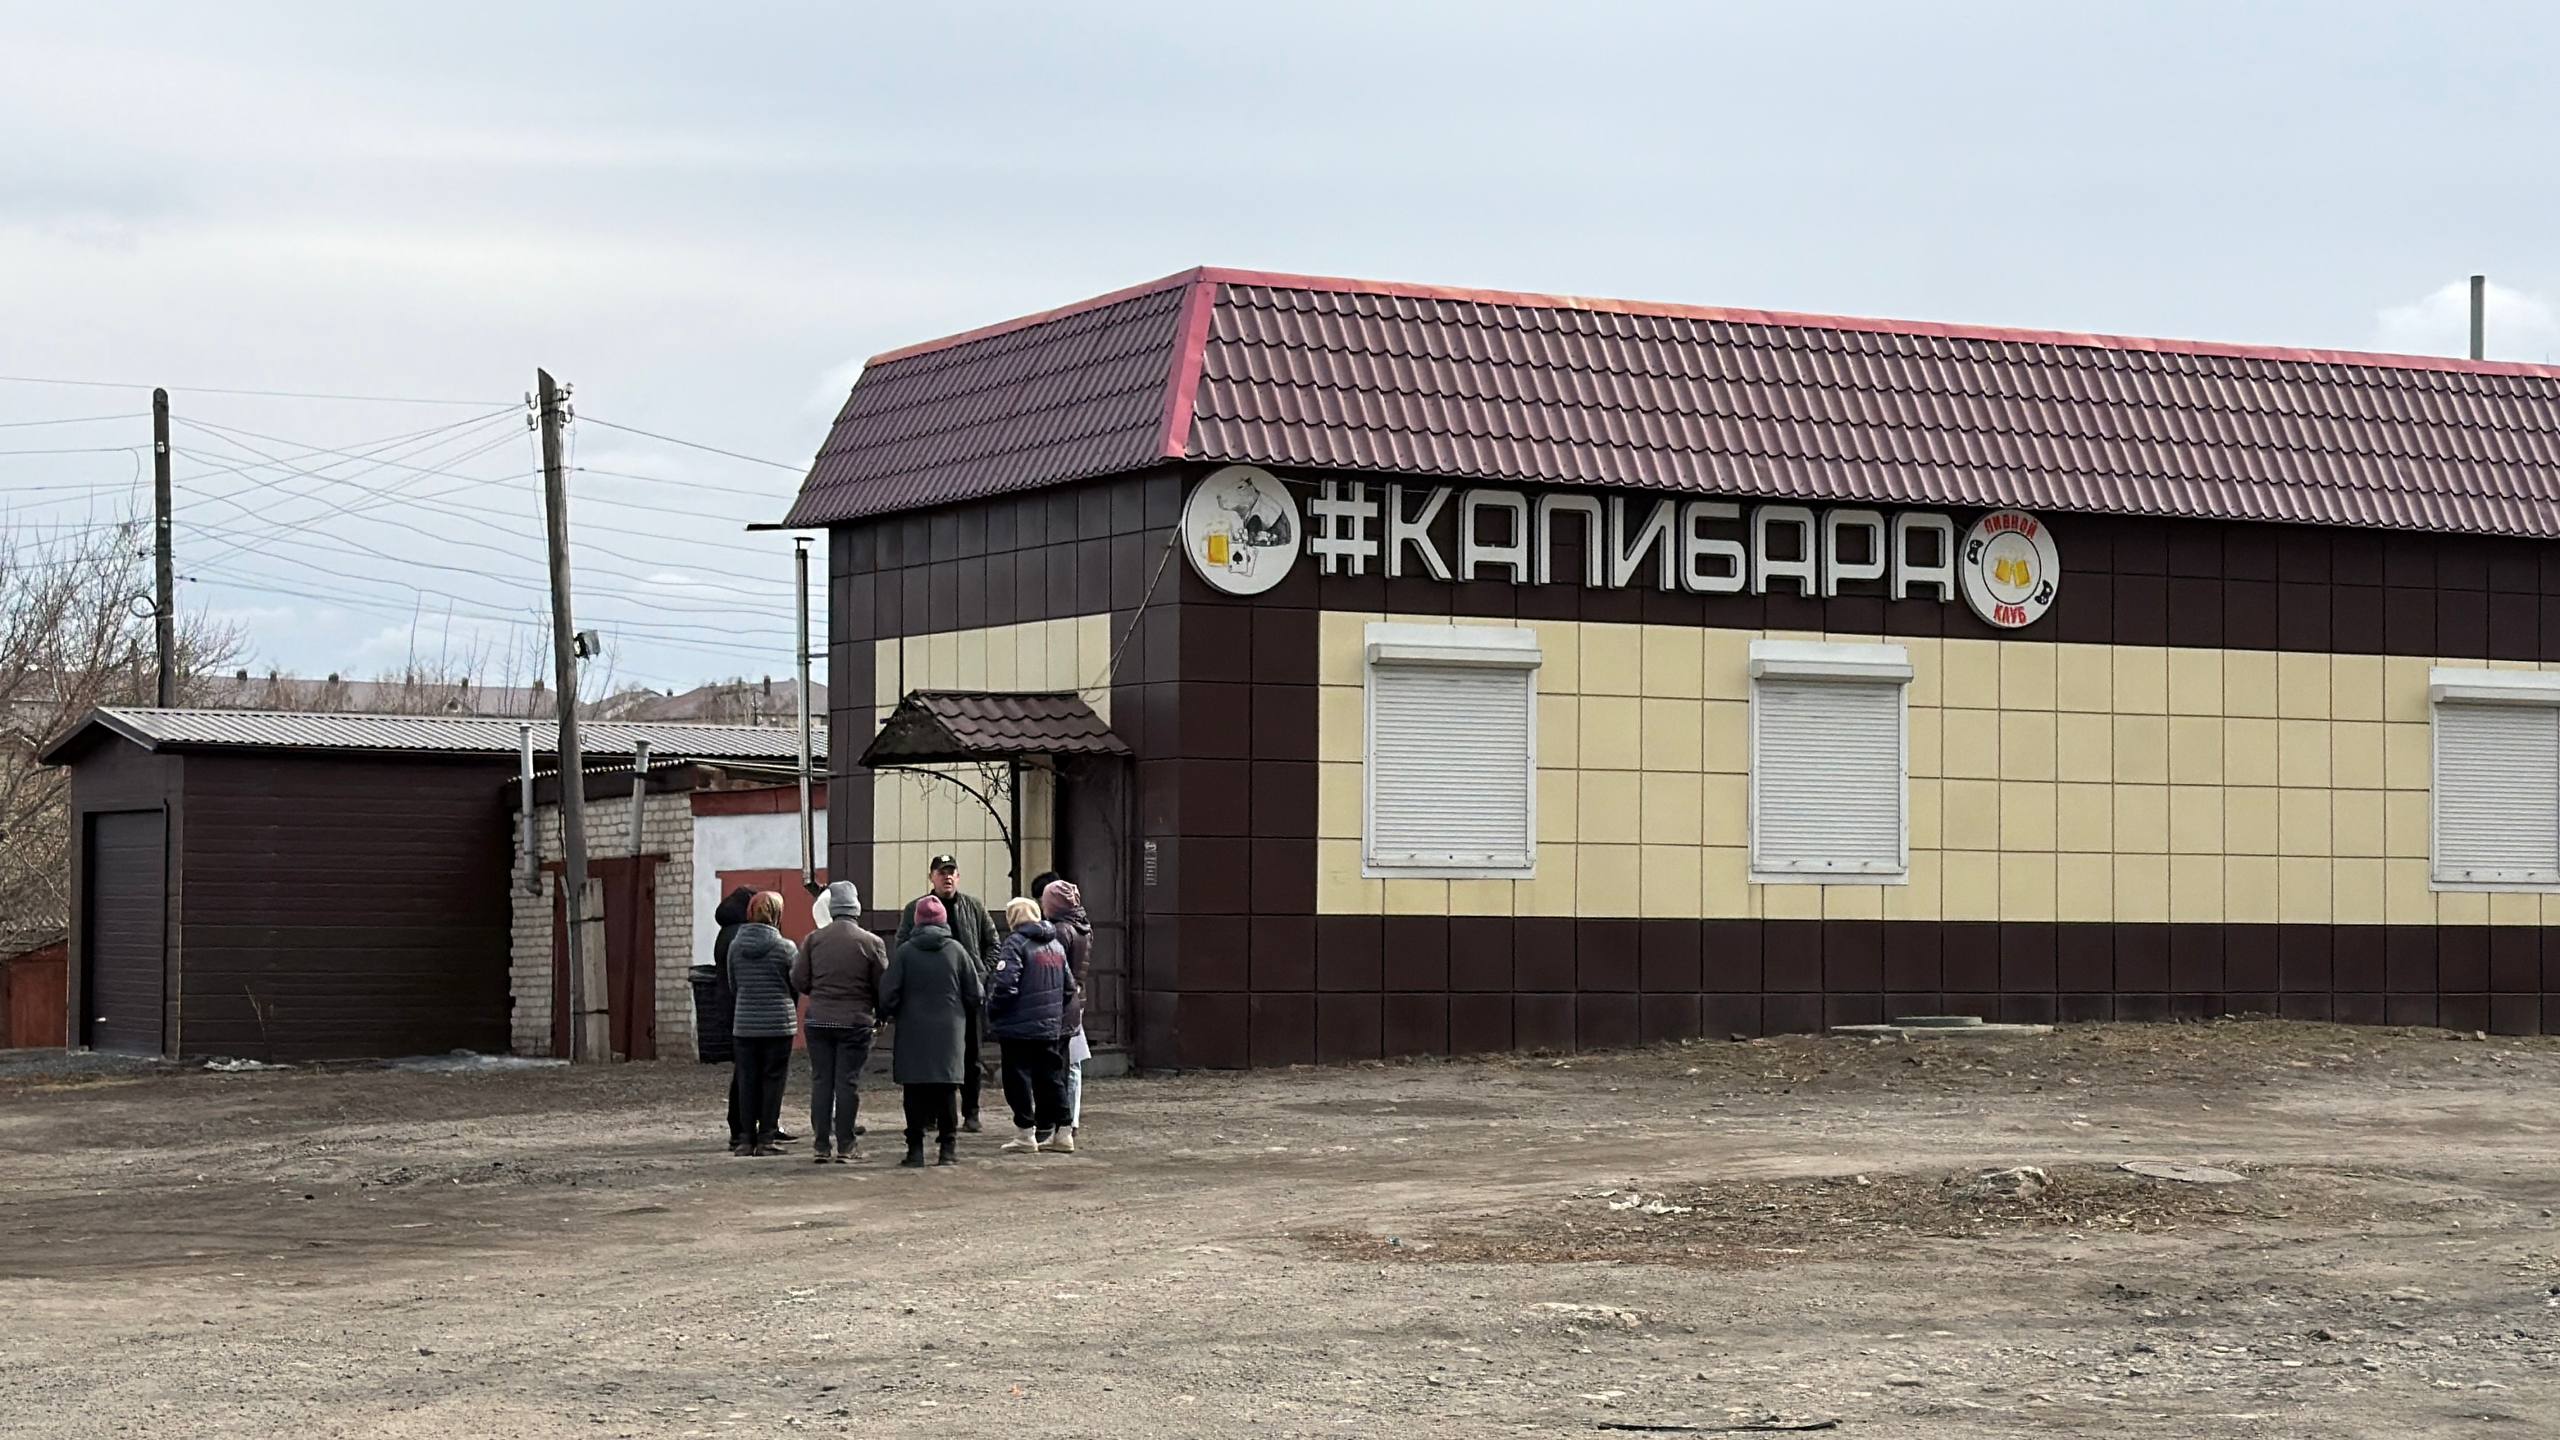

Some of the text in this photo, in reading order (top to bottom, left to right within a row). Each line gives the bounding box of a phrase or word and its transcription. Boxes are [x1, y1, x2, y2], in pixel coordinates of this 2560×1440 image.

[1984, 514, 2038, 539] ПИВНОЙ
[1308, 479, 1955, 602] #КАПИБАРА
[1993, 603, 2027, 624] КЛУБ
